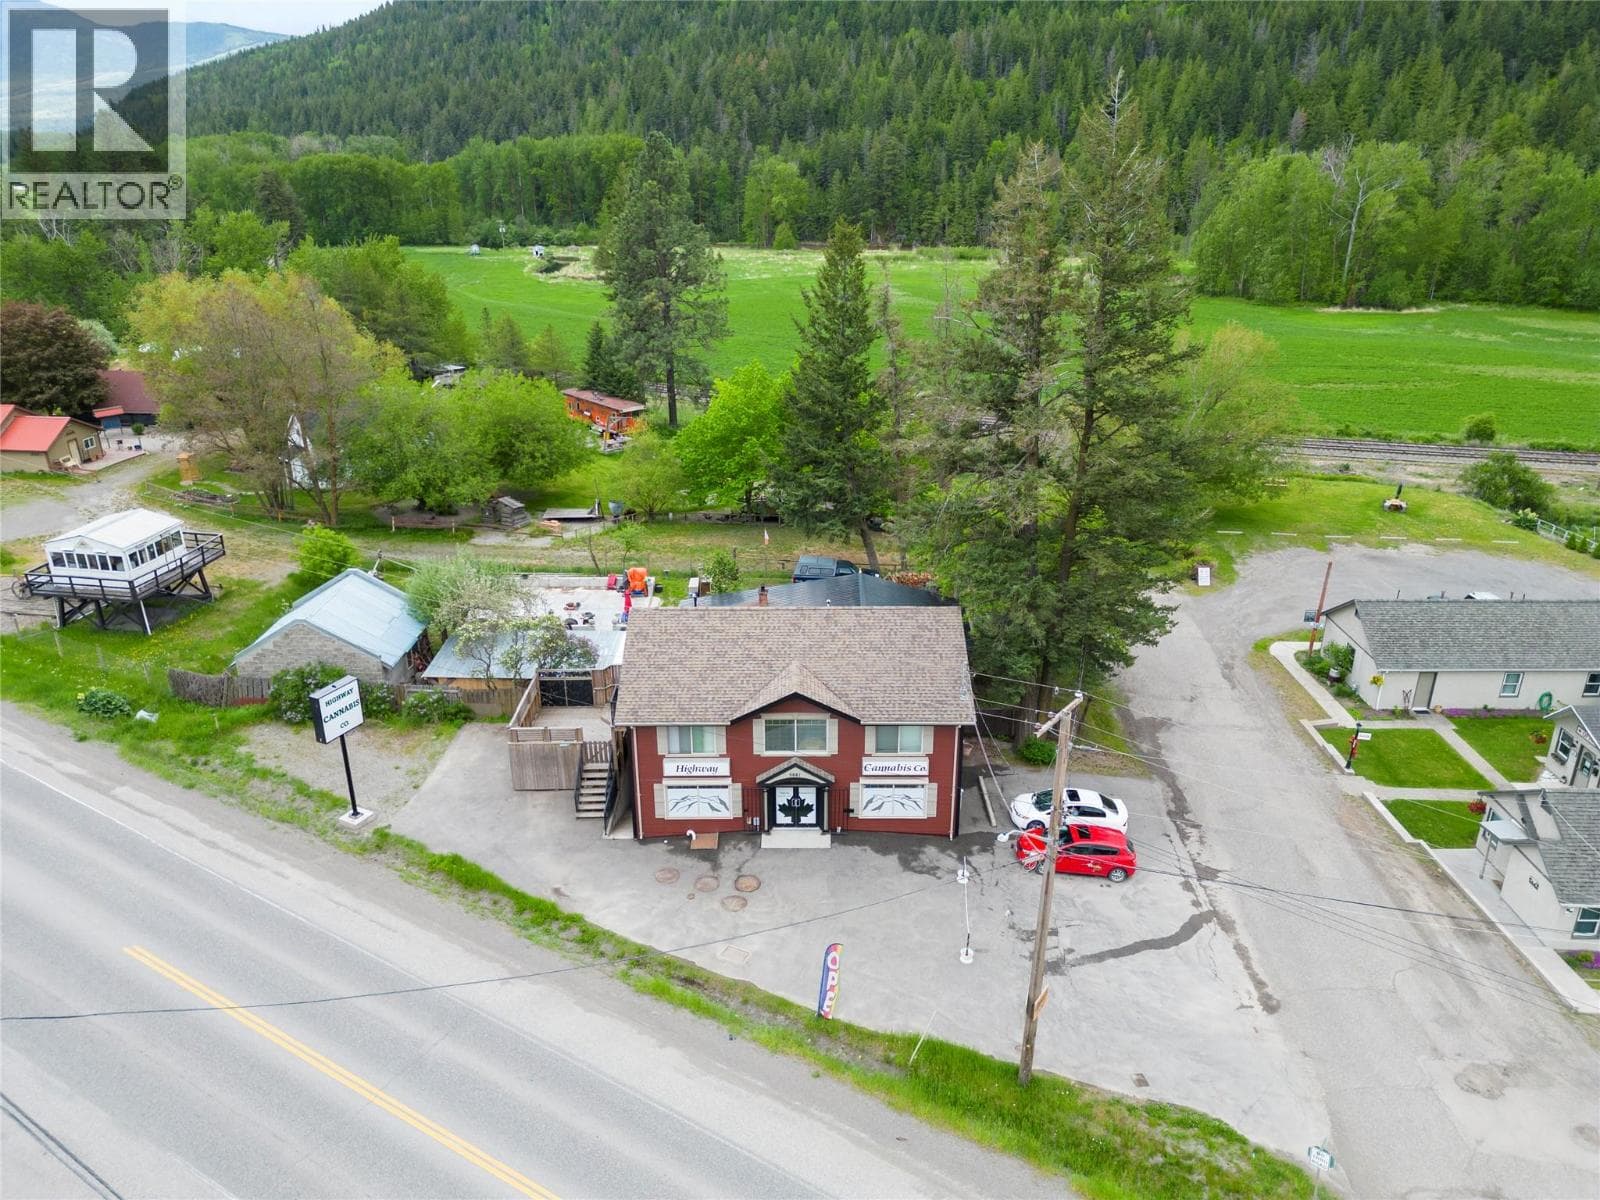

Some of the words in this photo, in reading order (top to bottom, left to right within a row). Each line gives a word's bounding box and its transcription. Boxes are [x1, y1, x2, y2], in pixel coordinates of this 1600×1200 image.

[325, 688, 354, 707] HIGHWAY
[323, 699, 360, 723] CANNABIS
[676, 764, 719, 774] Highway
[864, 763, 912, 772] Cannabis
